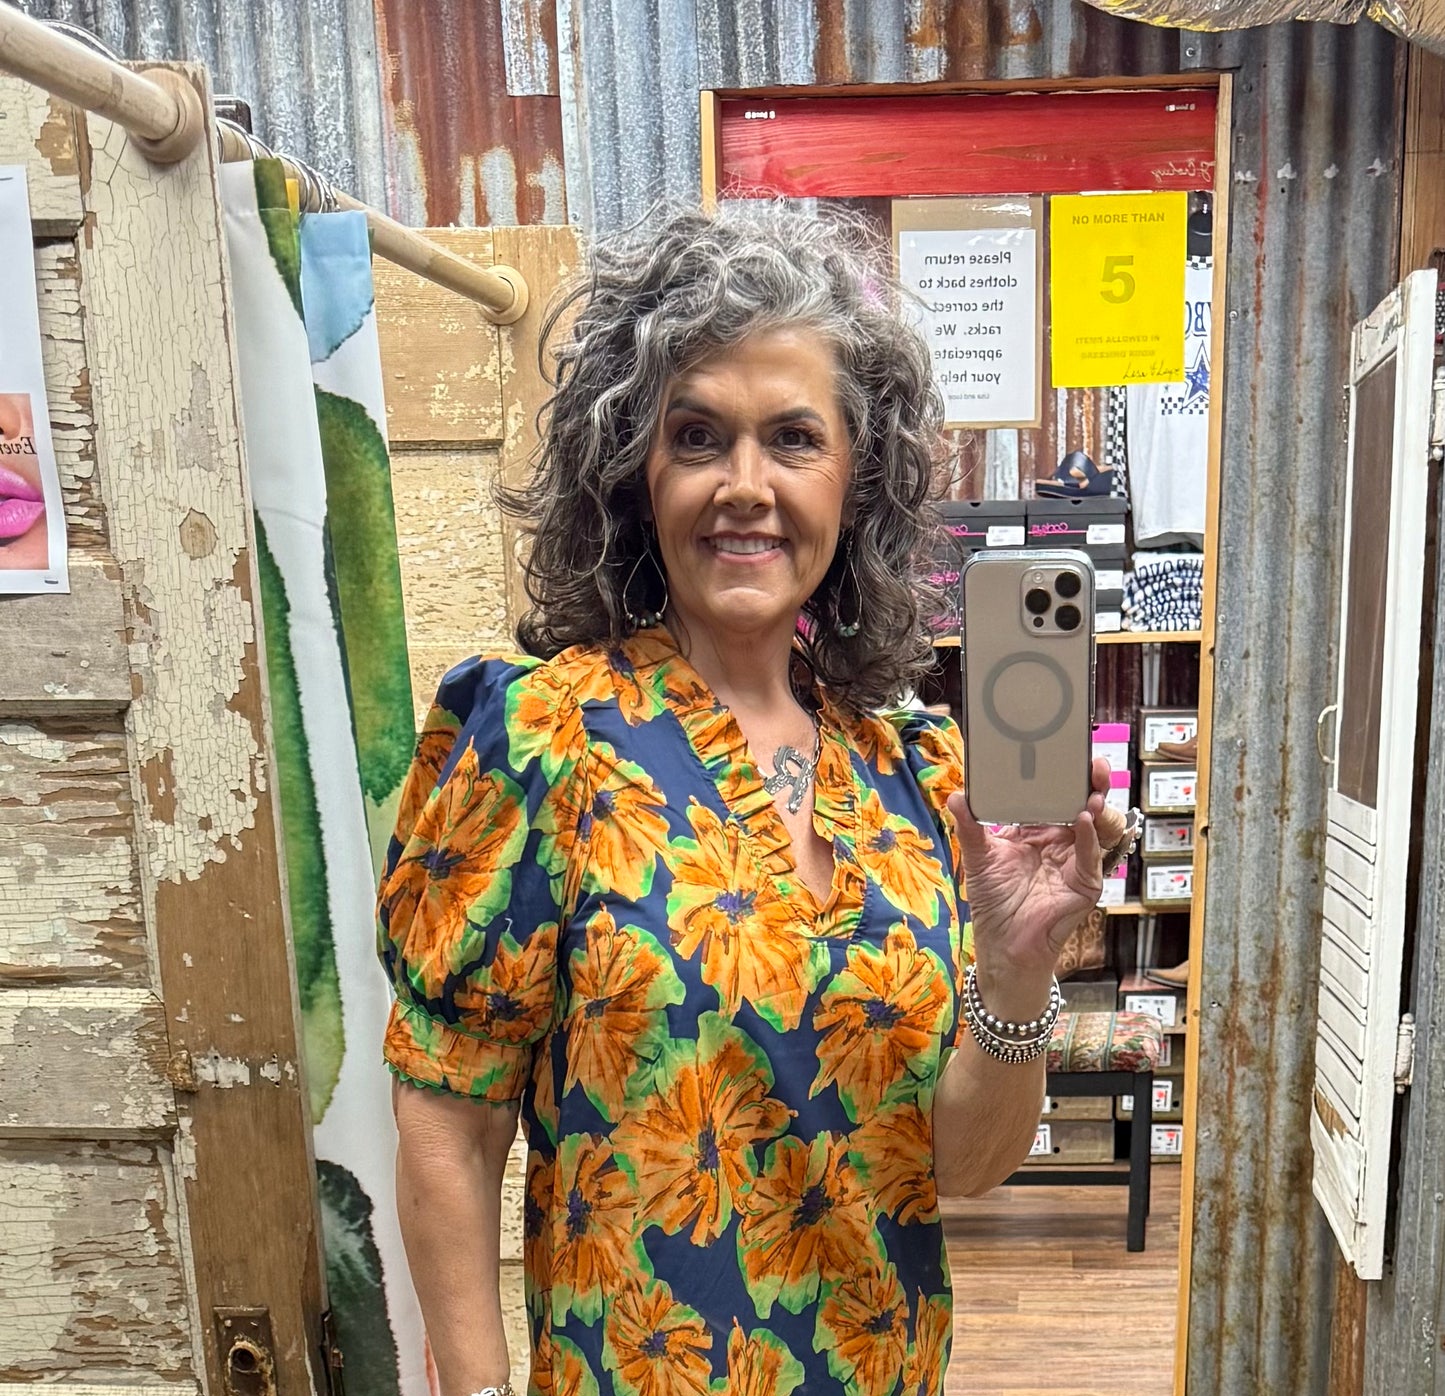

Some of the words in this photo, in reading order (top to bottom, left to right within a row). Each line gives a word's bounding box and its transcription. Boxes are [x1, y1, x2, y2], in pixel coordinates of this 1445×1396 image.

[1072, 214, 1089, 225] NO
[1093, 213, 1128, 224] MORE
[1131, 212, 1165, 223] THAN
[1099, 254, 1136, 305] 5
[1105, 334, 1149, 344] ALLOWED
[1150, 333, 1161, 343] IN
